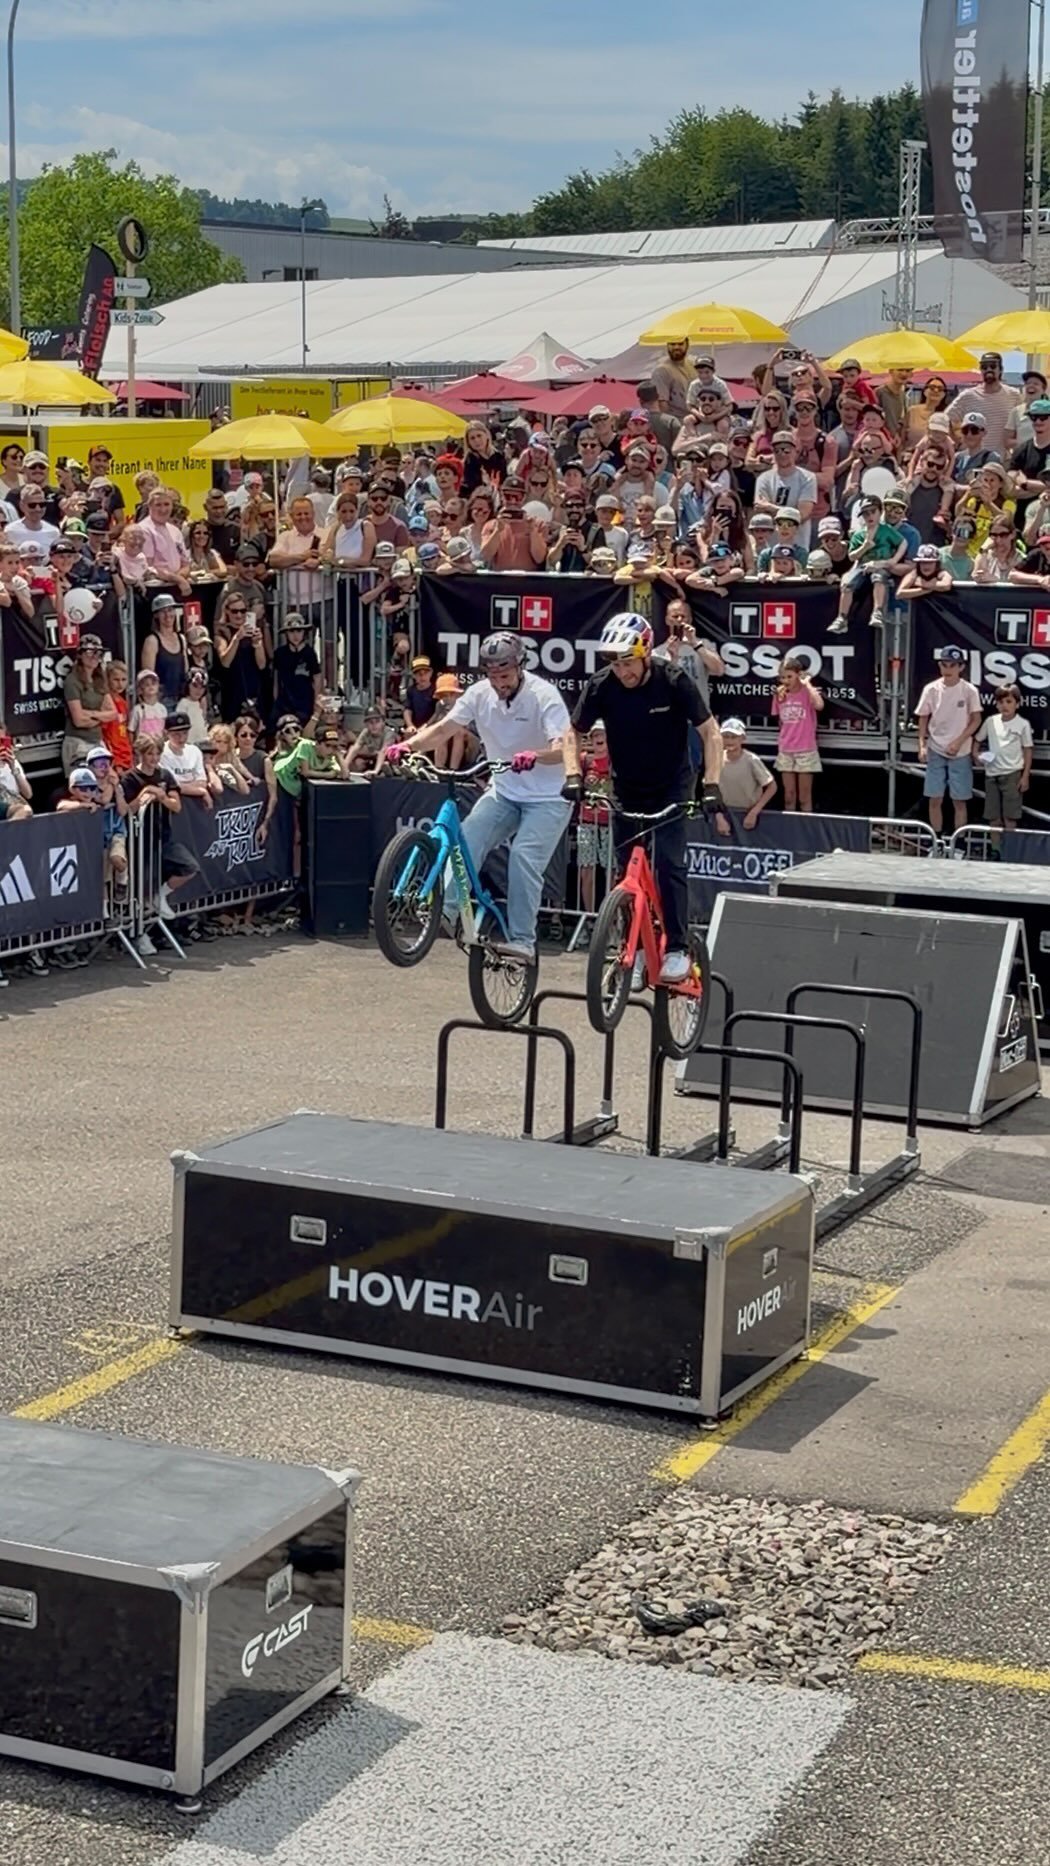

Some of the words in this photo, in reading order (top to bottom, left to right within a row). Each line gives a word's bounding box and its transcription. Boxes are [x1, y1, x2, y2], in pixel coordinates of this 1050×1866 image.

[114, 312, 154, 324] Kids-Zone
[156, 456, 179, 471] Ihrer
[495, 600, 516, 625] T
[733, 607, 756, 633] T
[1000, 613, 1027, 641] T
[437, 632, 601, 674] TISOT
[719, 642, 855, 682] SSOT
[934, 648, 1050, 689] ISS
[717, 683, 777, 696] WATCHES
[826, 688, 856, 699] 1853
[980, 693, 1048, 708] WHES
[688, 849, 788, 878] Muc-Off
[329, 1265, 543, 1331] HOVERAir
